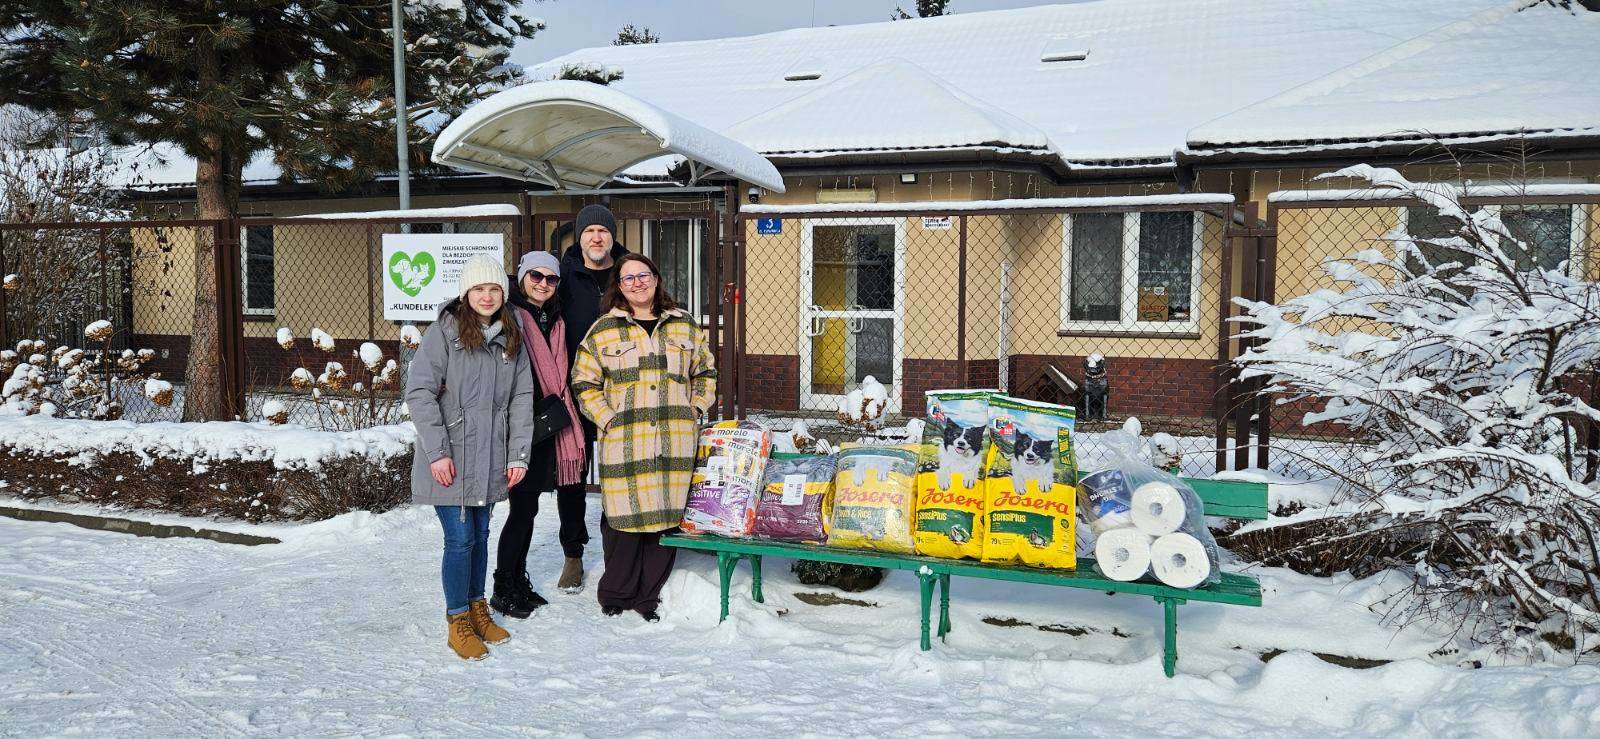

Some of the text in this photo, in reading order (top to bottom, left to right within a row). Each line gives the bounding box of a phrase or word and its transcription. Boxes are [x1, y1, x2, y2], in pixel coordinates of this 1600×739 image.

[717, 428, 749, 437] morele
[834, 487, 905, 505] Josera
[993, 491, 1071, 516] Josera
